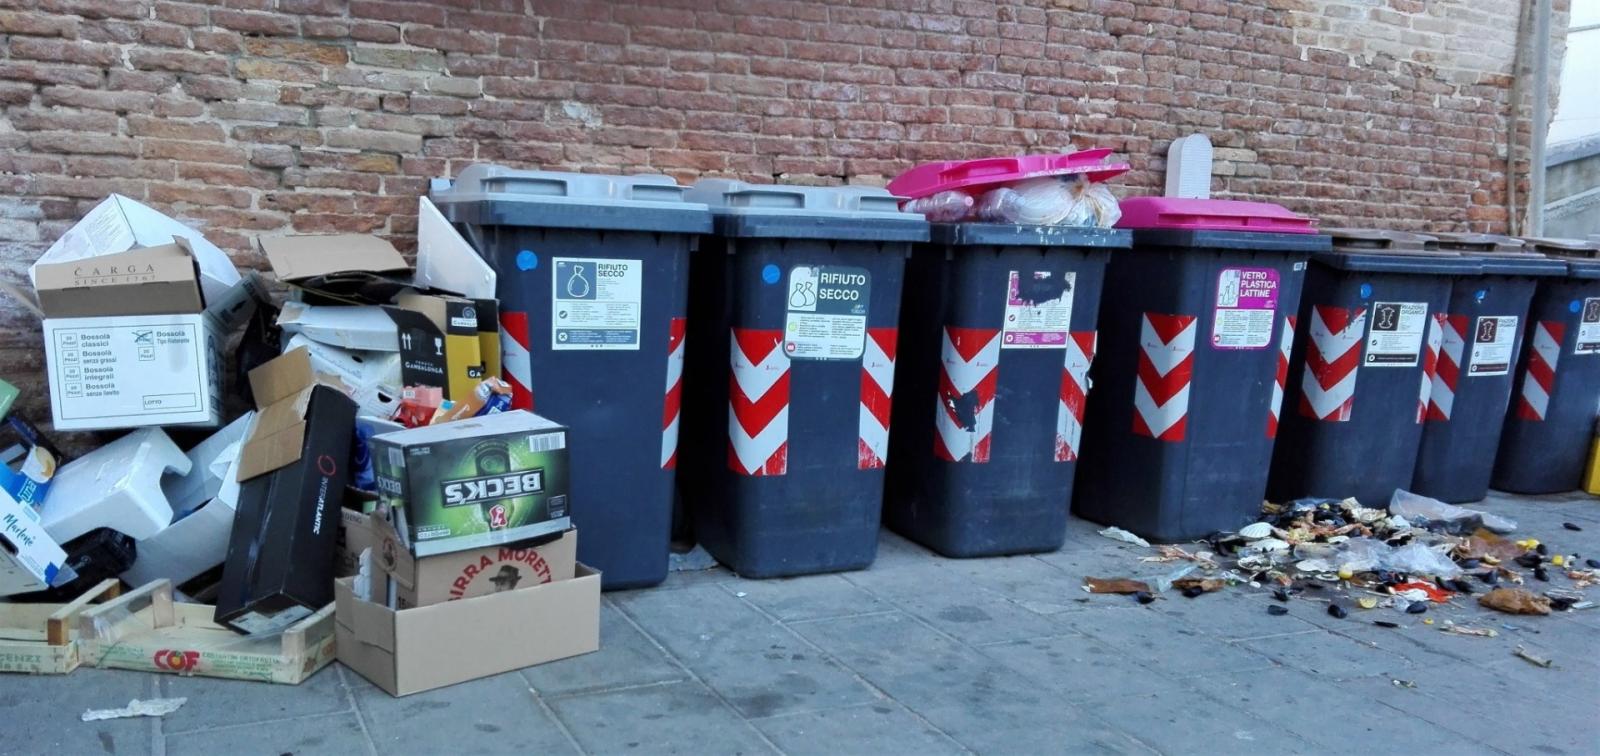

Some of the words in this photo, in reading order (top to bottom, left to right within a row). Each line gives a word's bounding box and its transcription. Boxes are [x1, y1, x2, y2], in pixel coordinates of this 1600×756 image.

[598, 263, 628, 271] RIFIUTO
[598, 270, 625, 278] SECCO
[1242, 271, 1267, 280] VETRO
[74, 277, 118, 286] SINCE
[820, 273, 866, 286] RIFIUTO
[1240, 280, 1277, 289] PLASTICA
[819, 289, 860, 301] SECCO
[1240, 289, 1271, 298] LATTINE
[445, 472, 541, 504] BECK'S
[3, 513, 34, 547] Marlene
[448, 555, 494, 601] IRRA
[498, 548, 553, 584] MORETT
